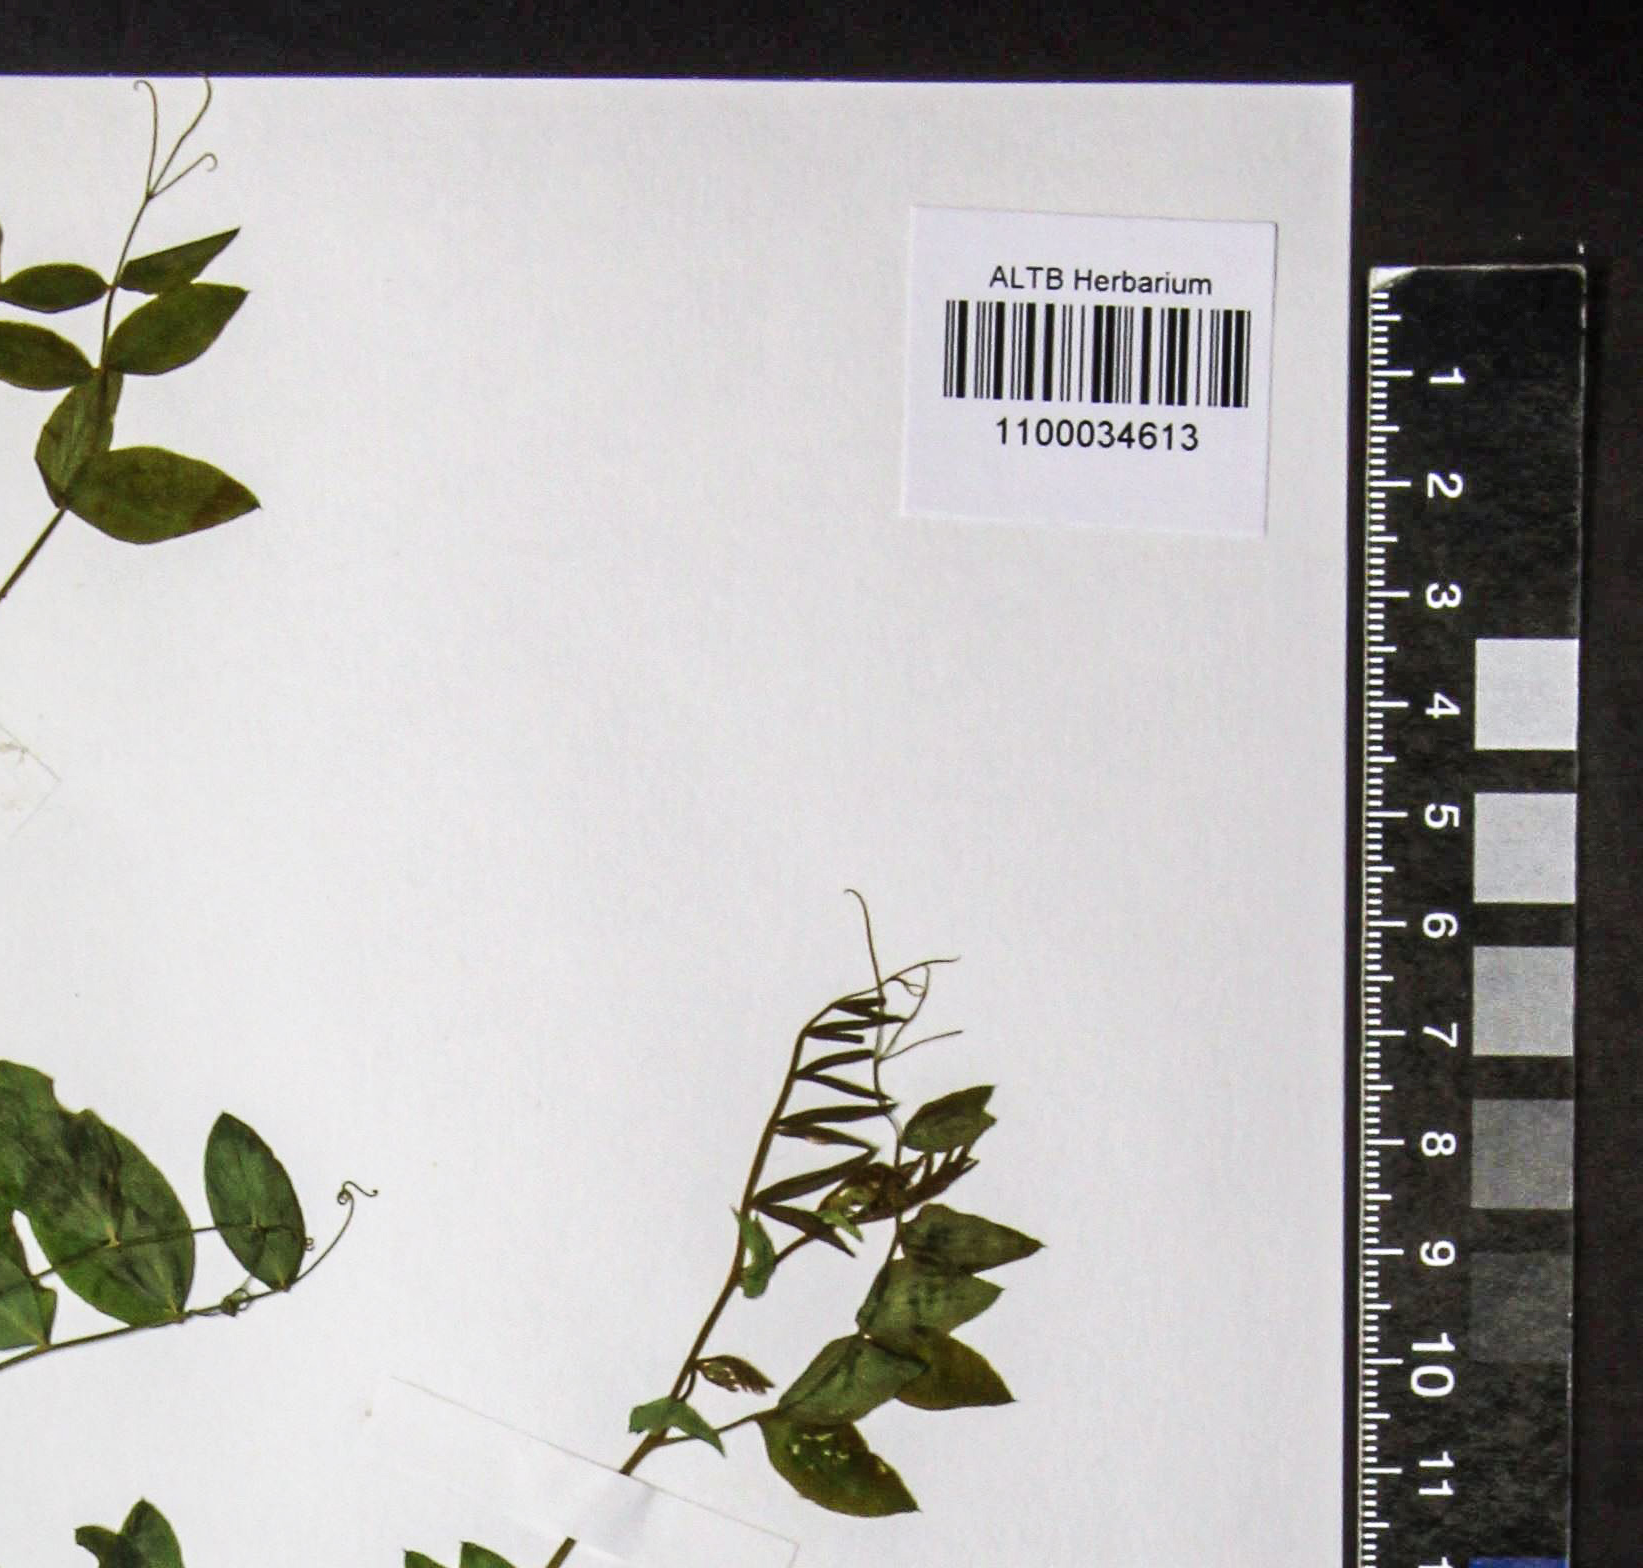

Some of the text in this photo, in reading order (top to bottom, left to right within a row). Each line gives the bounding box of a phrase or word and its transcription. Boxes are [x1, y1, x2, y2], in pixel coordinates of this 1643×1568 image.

[989, 265, 1213, 296] ALTB Herbarium
[1428, 367, 1466, 385] 1
[996, 417, 1200, 452] 1100034613
[1426, 472, 1464, 499] 2
[1425, 582, 1462, 610] 3
[1425, 692, 1461, 720] 4
[1424, 803, 1461, 830] 5
[1422, 912, 1459, 939] 6
[1422, 1022, 1458, 1048] 7
[1420, 1131, 1457, 1157] 8
[1419, 1239, 1456, 1267] 9
[1410, 1331, 1456, 1398] 10
[1418, 1450, 1455, 1497] 11
